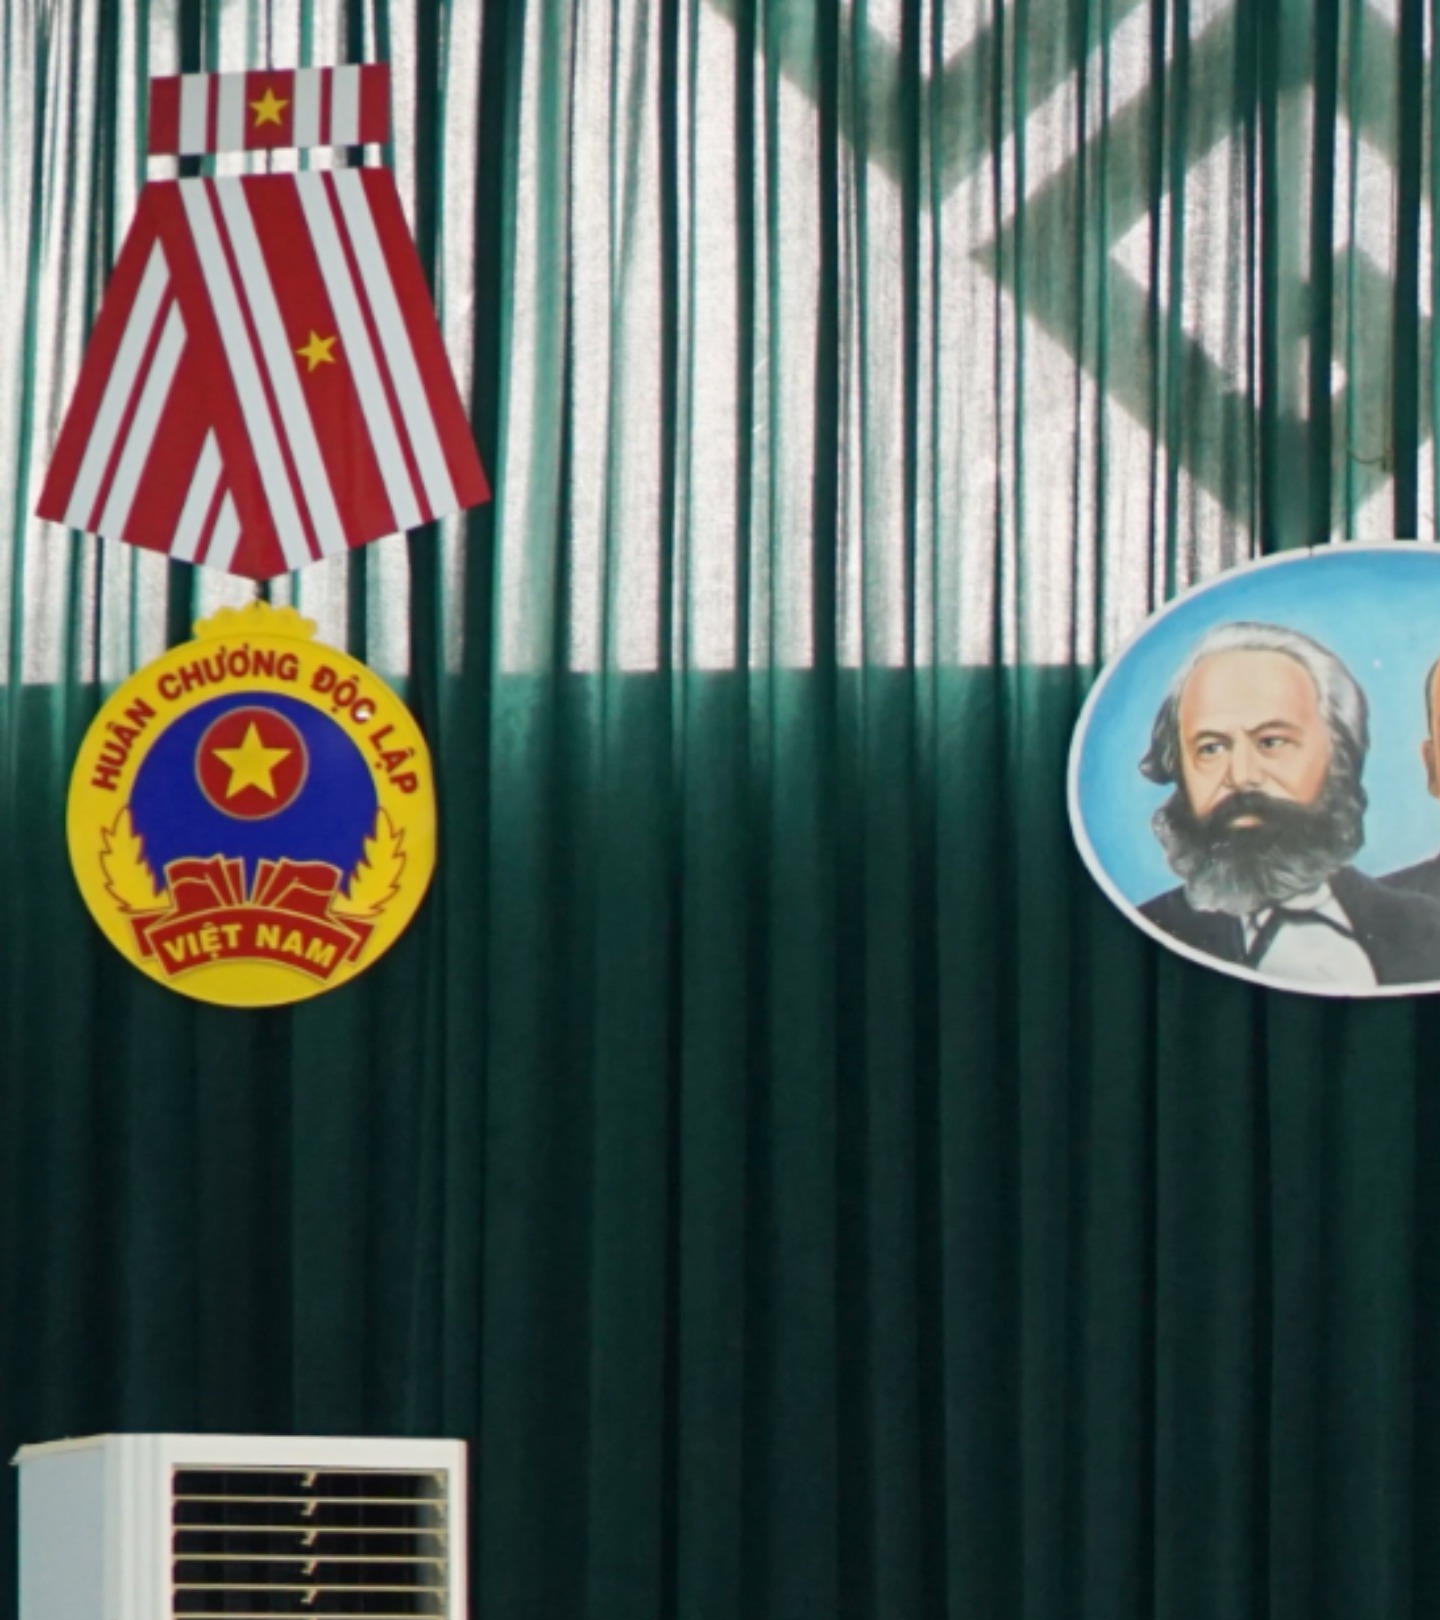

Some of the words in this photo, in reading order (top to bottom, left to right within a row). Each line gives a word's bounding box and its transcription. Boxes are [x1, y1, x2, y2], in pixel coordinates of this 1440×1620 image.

[91, 698, 157, 793] HUÂN
[157, 643, 300, 701] CHƯƠNG
[309, 665, 378, 726] ĐỘC
[370, 724, 420, 796] LẬP
[163, 920, 242, 962] VIỆT
[255, 925, 336, 968] NAM
